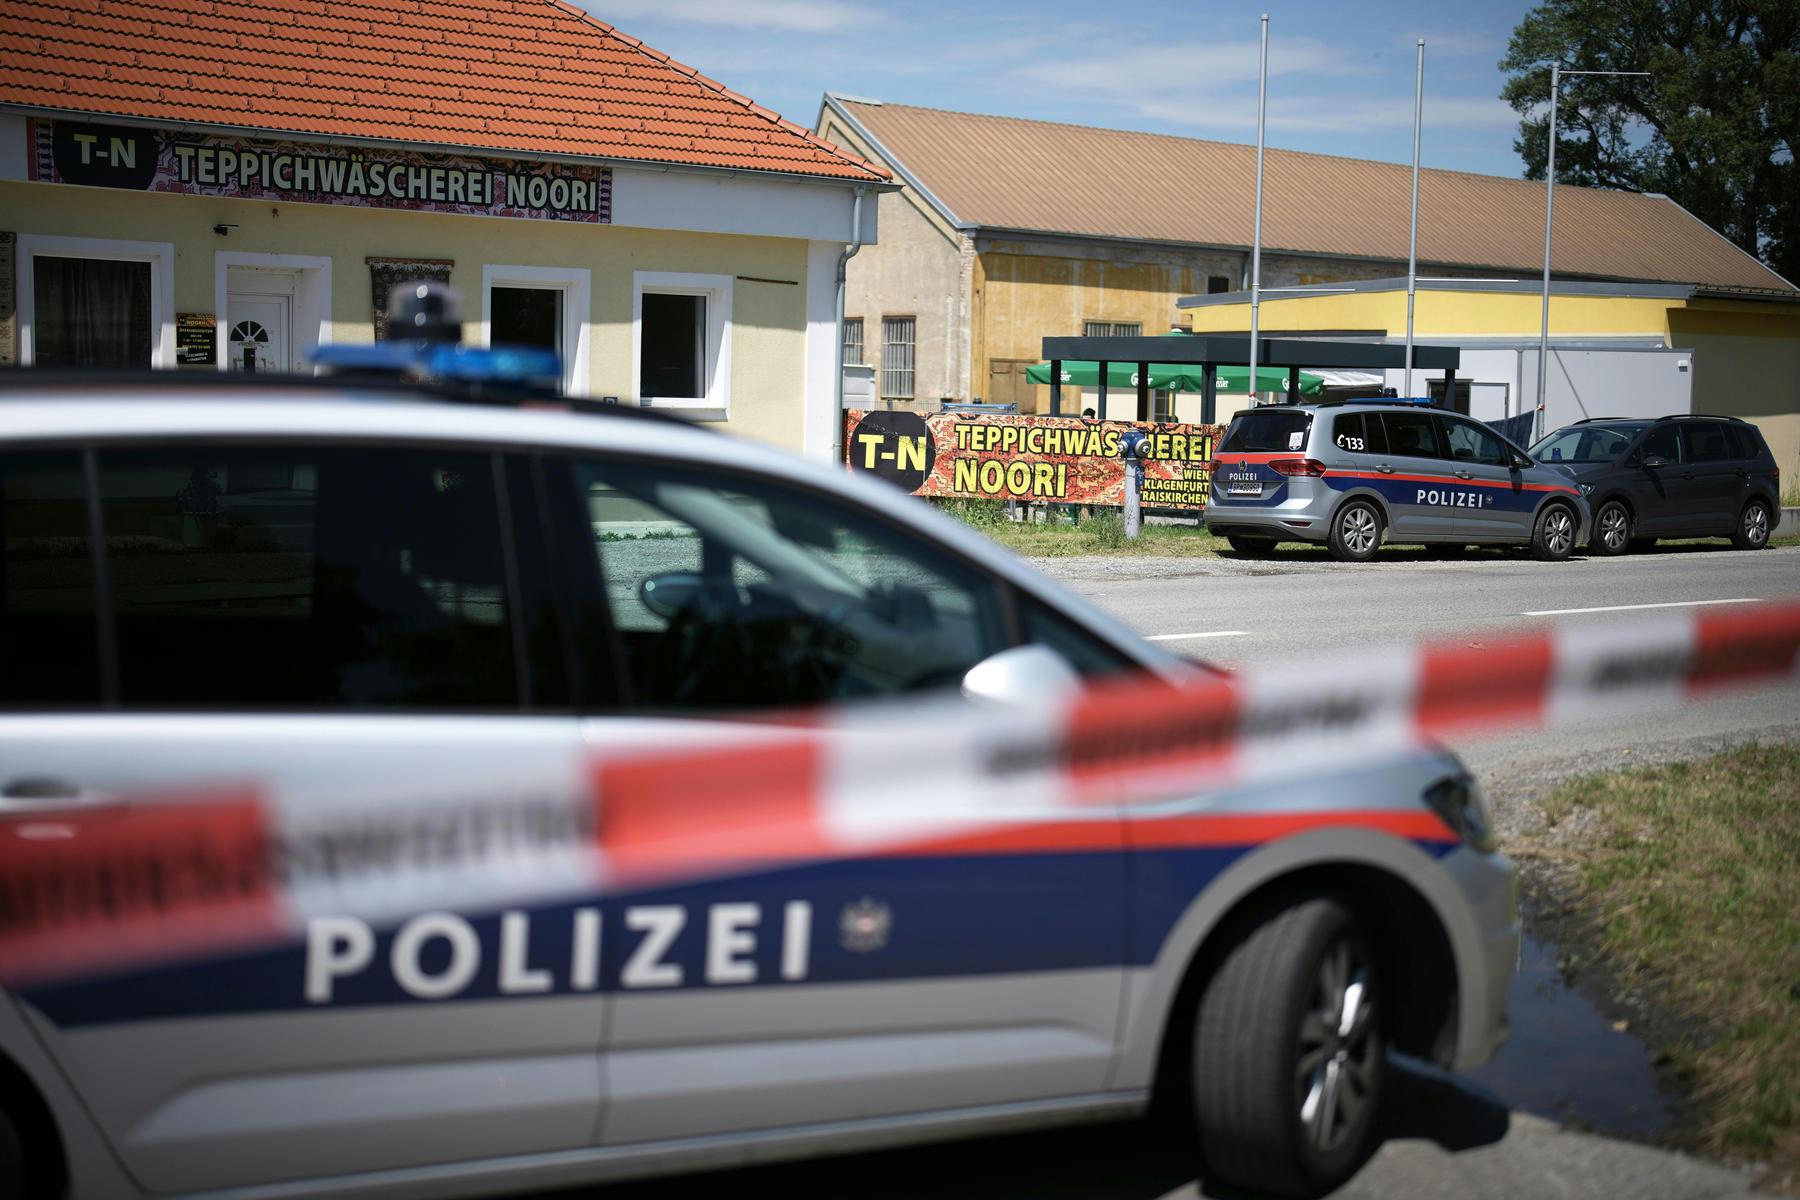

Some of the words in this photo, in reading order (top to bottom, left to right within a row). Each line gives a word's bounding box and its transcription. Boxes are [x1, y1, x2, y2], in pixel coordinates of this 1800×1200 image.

[73, 133, 136, 169] T-N
[174, 146, 492, 205] TEPPICHWÄSCHEREI
[507, 175, 596, 212] NOORI
[858, 433, 926, 471] T-N
[955, 424, 1212, 461] TEPPICHWÄSEREI
[1345, 437, 1364, 450] 133
[954, 458, 1067, 498] NOORI
[1144, 479, 1209, 492] KLAGENFURT
[1184, 469, 1209, 480] WIEN
[1229, 472, 1257, 481] POLIZEI
[1416, 489, 1483, 508] POLIZEI
[304, 900, 813, 1003] POLIZEI
